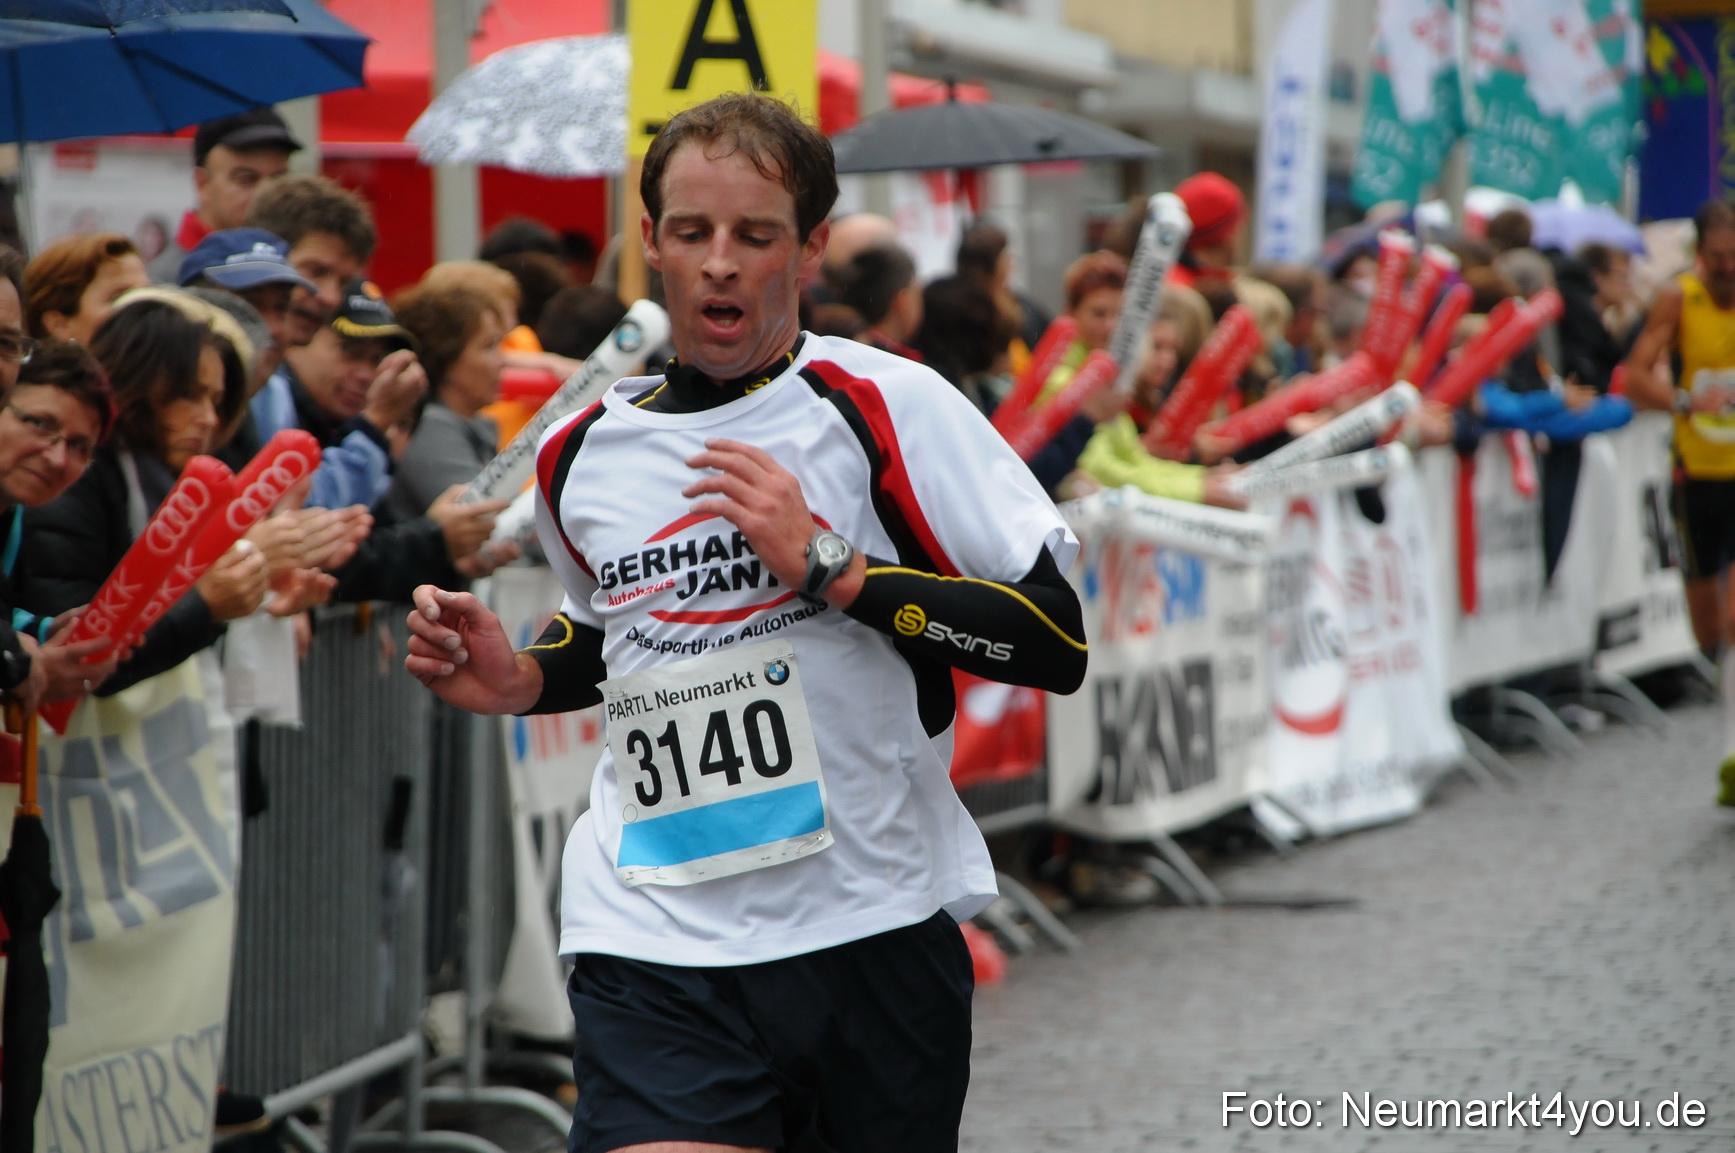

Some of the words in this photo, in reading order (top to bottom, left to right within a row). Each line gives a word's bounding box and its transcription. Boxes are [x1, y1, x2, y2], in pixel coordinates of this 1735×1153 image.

[667, 0, 773, 91] A
[600, 530, 756, 590] GERHAR
[84, 566, 143, 636] BKK
[608, 578, 676, 607] Autohaus
[740, 600, 829, 641] Autohaus
[608, 696, 653, 722] PARTL
[654, 671, 757, 709] Neumarkt
[626, 699, 793, 807] 3140
